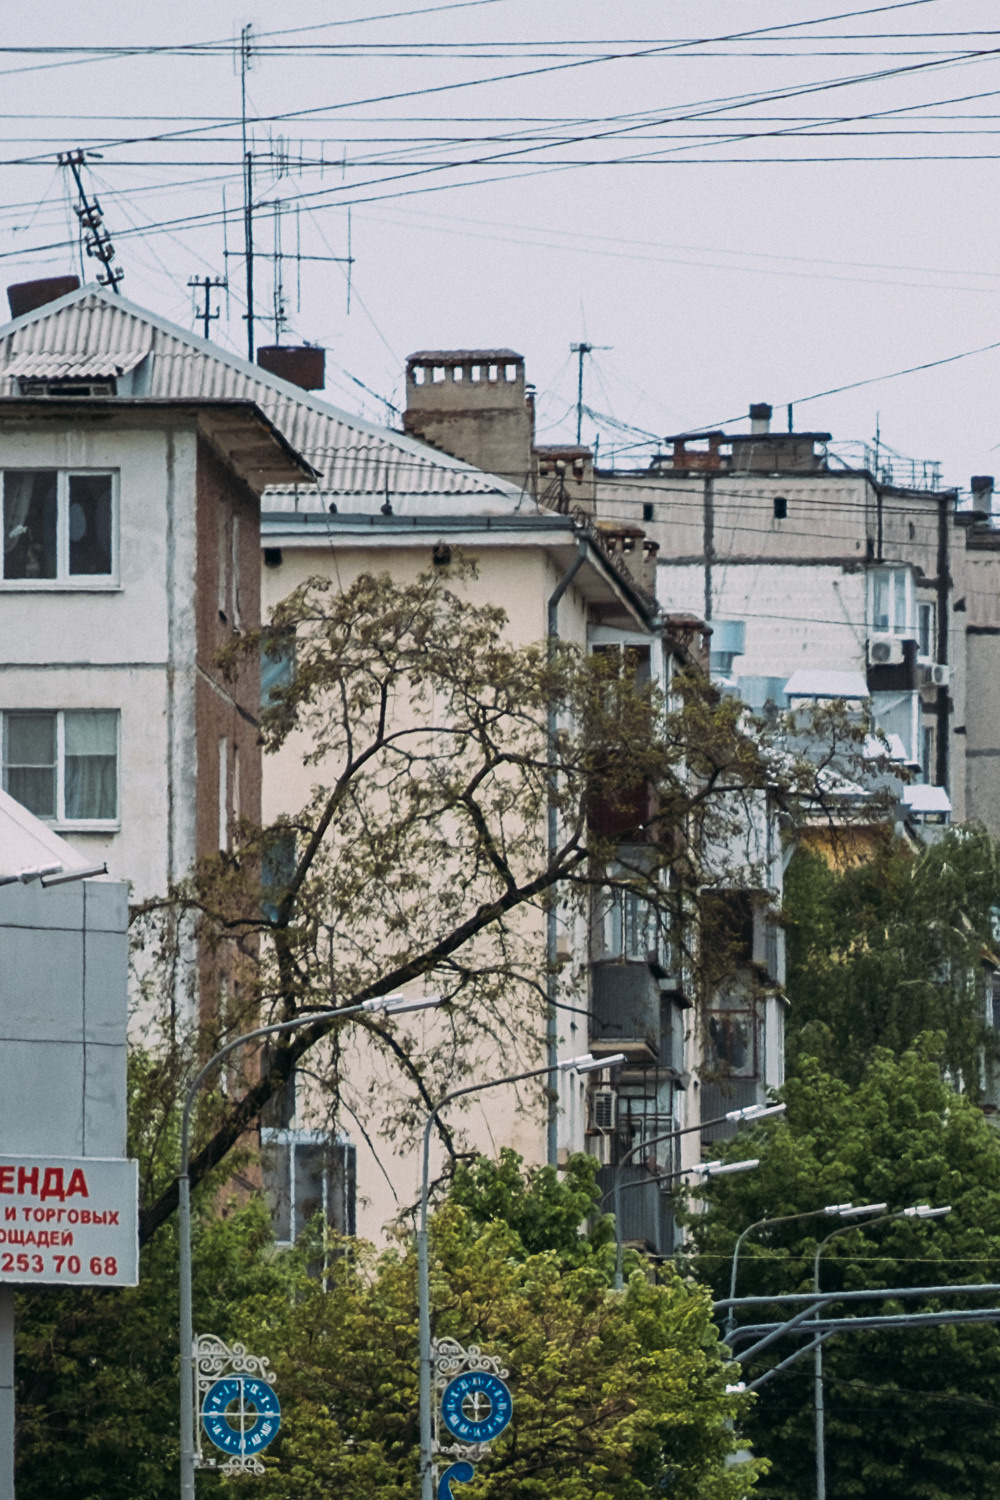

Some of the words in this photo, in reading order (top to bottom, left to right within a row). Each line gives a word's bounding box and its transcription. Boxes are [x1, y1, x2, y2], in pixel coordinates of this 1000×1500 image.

[0, 1166, 89, 1202] ЕНДА
[5, 1207, 16, 1221] И
[22, 1207, 119, 1225] ТОРГОВЫХ
[1, 1252, 44, 1274] 253
[52, 1255, 81, 1274] 70
[89, 1256, 118, 1276] 68
